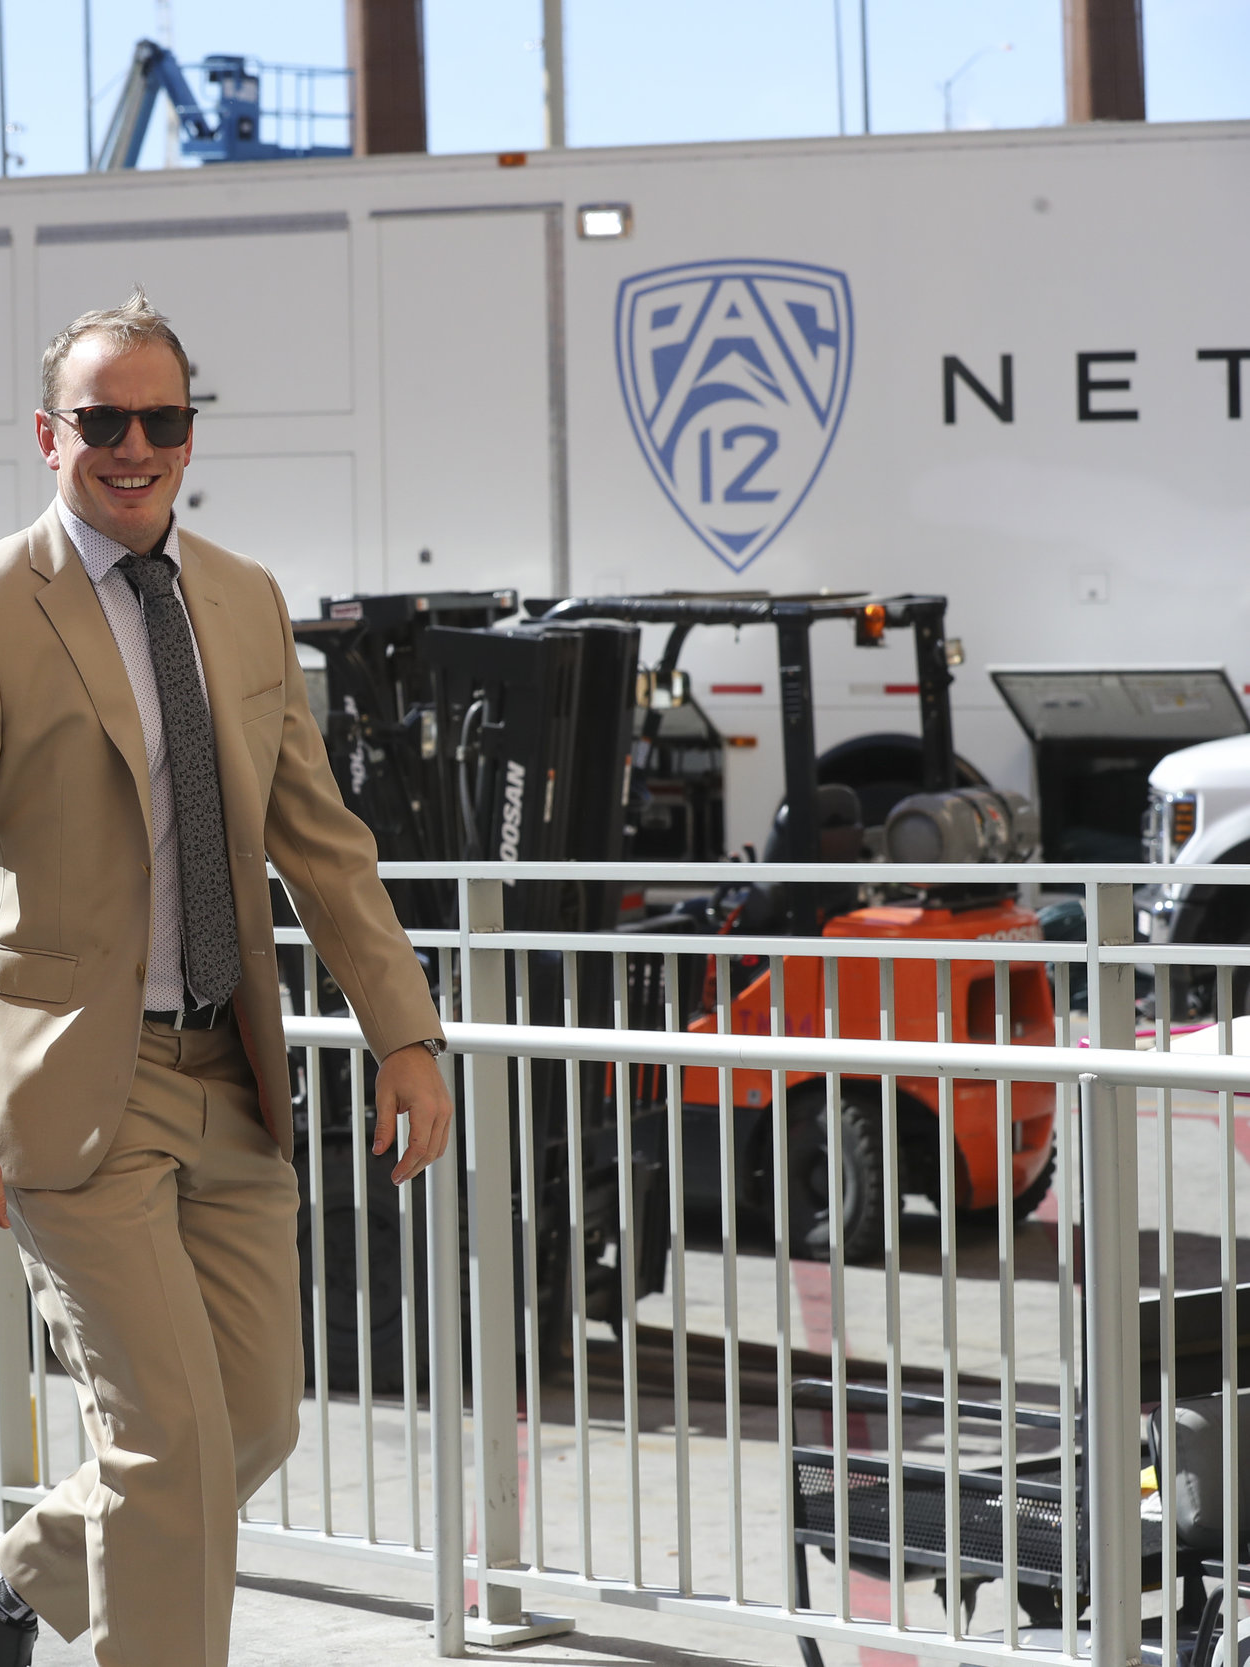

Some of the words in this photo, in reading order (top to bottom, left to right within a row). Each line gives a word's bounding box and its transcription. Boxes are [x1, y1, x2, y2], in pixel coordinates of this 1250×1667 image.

[632, 276, 839, 440] PAC
[942, 348, 1250, 426] NET
[699, 424, 781, 504] 12
[500, 760, 526, 887] OOSAN
